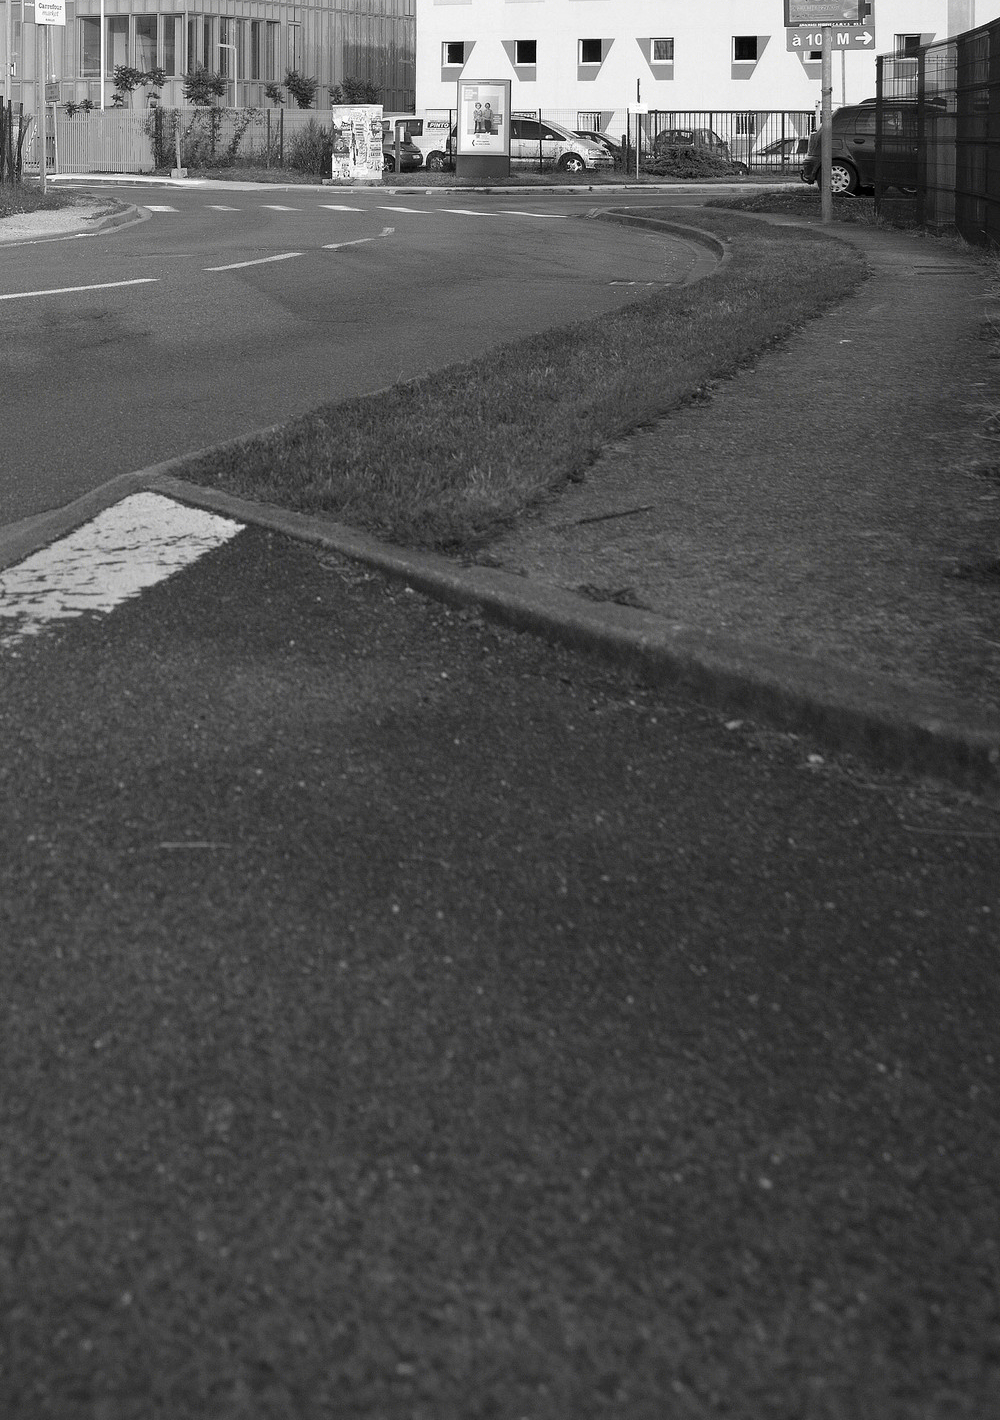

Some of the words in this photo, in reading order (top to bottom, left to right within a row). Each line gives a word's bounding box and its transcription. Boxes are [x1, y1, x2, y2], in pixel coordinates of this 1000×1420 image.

[792, 32, 802, 47] à
[805, 33, 833, 46] 10
[836, 32, 850, 45] M
